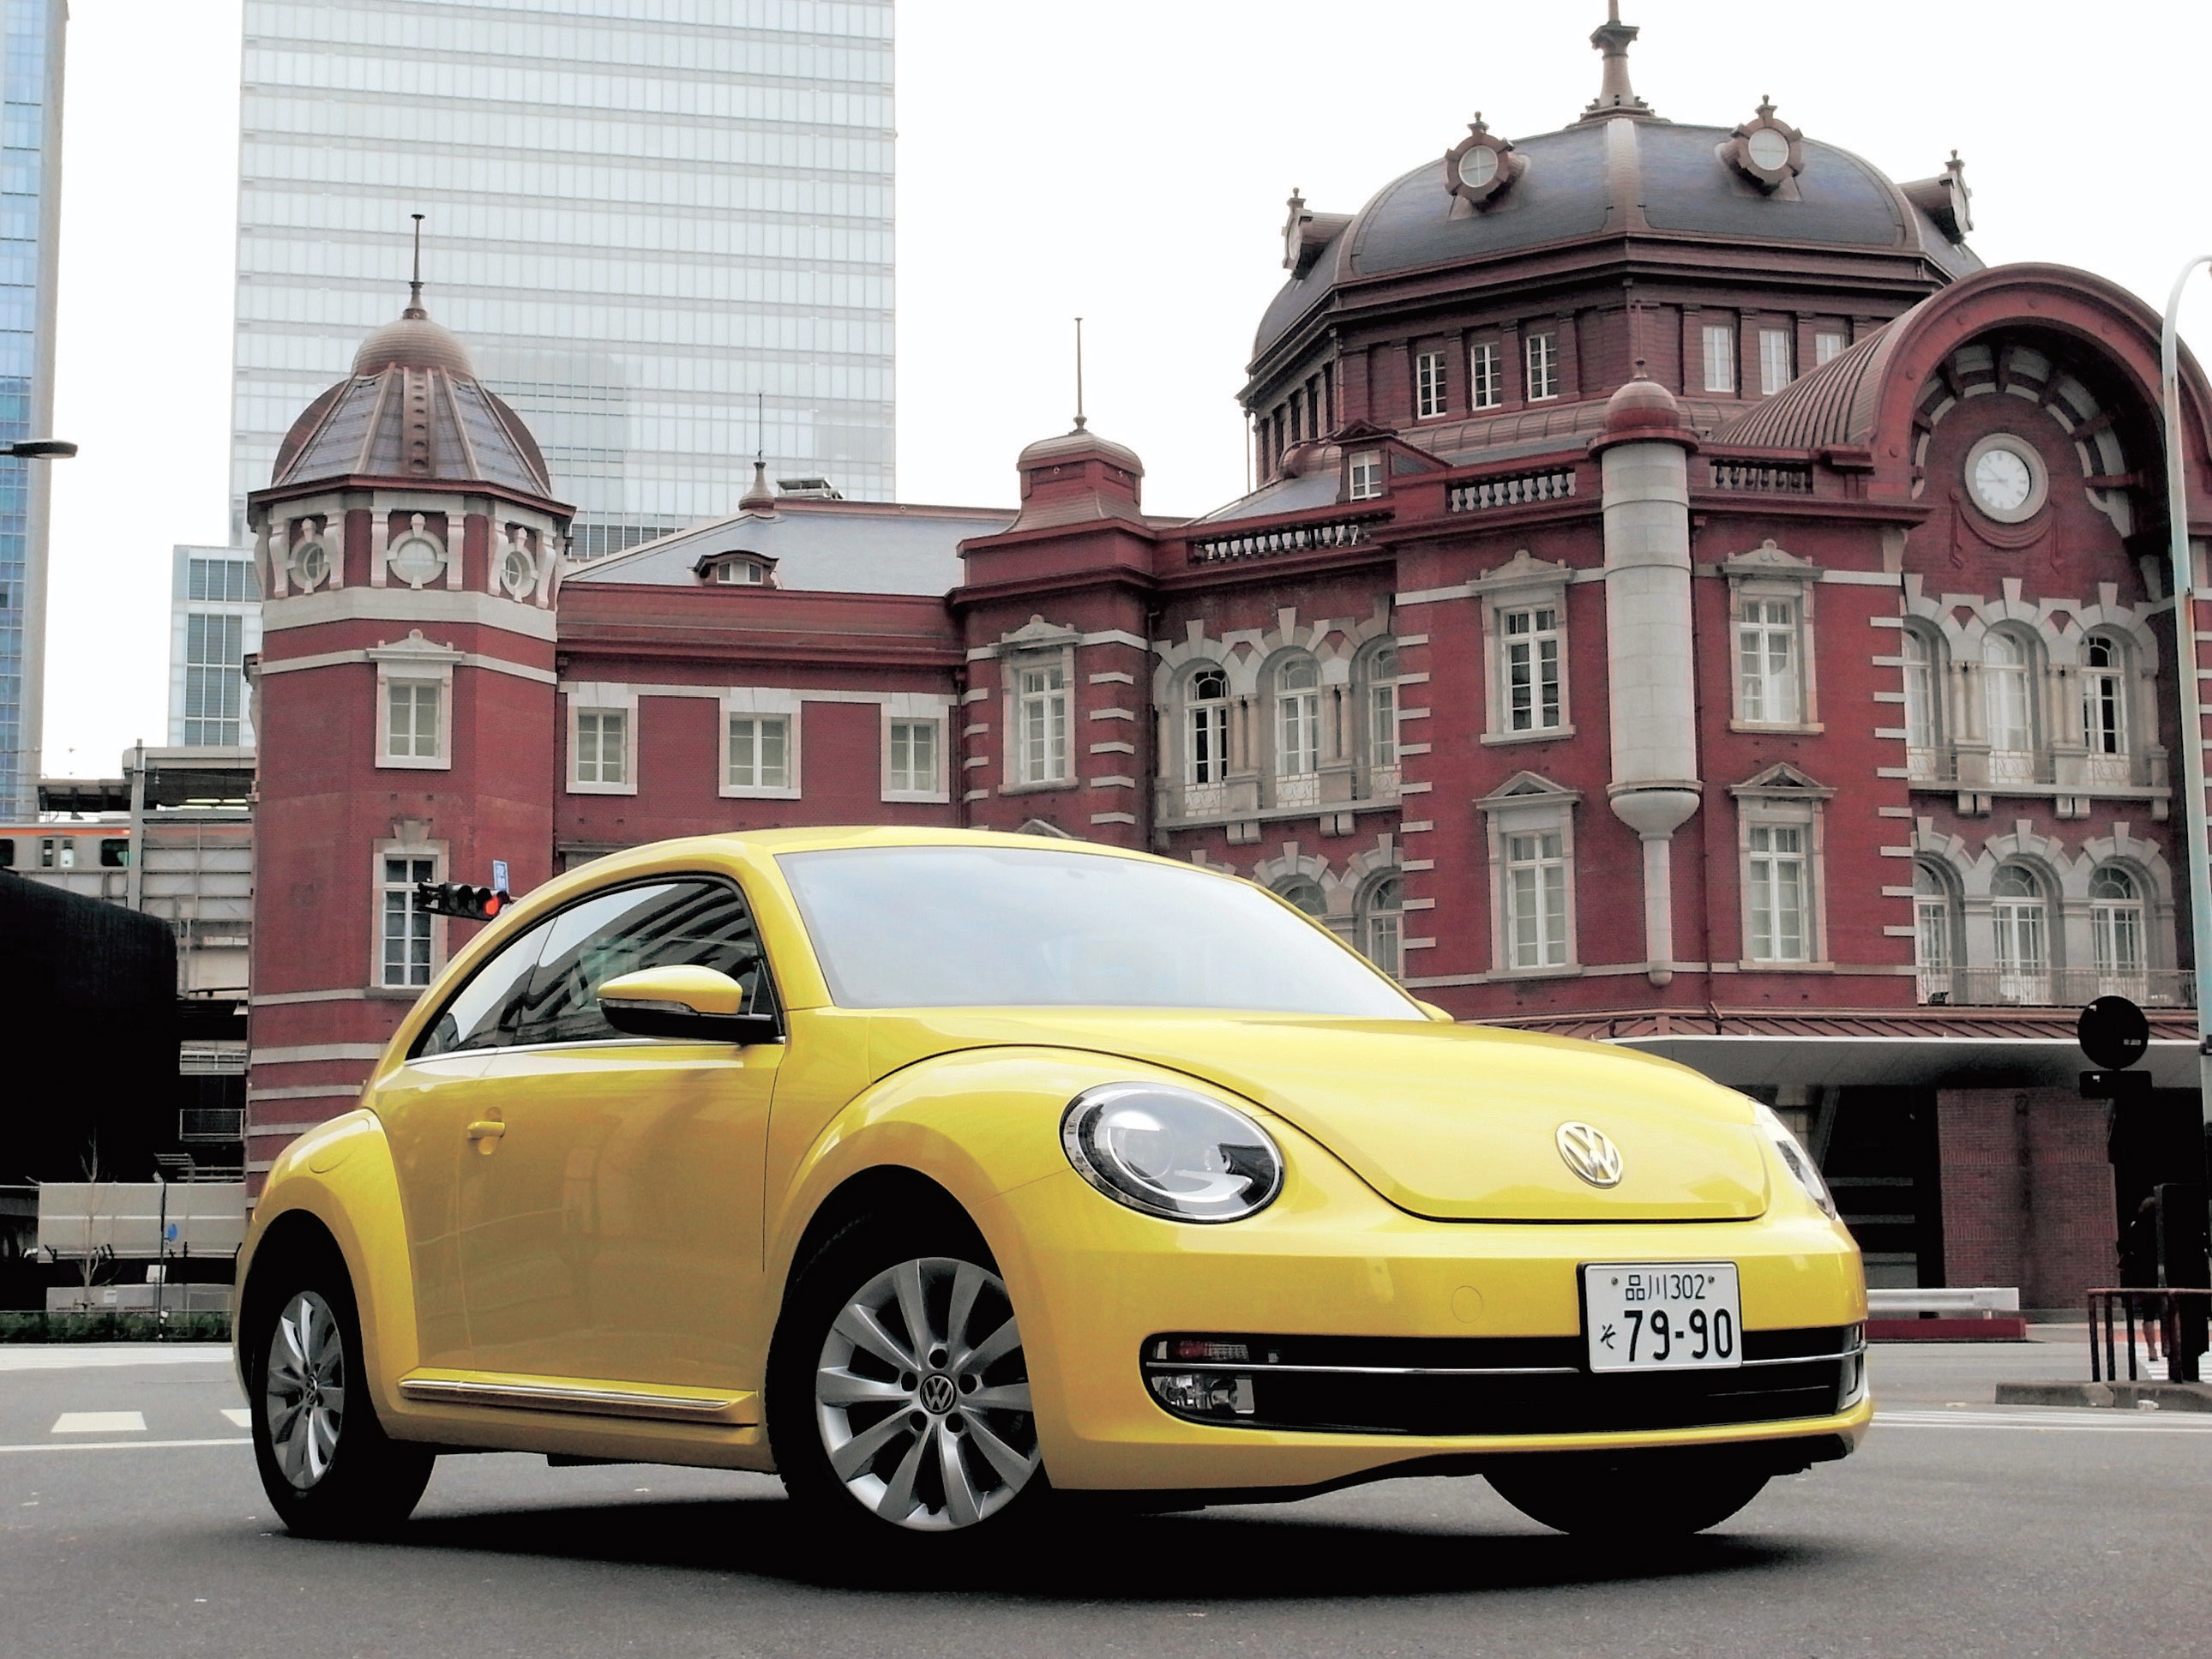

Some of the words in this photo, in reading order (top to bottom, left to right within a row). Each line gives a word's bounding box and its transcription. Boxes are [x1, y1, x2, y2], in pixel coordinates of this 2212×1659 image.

[1557, 1122, 1622, 1188] VW
[1600, 1324, 1616, 1349] そ
[1624, 1308, 1733, 1361] 79-90
[922, 1375, 954, 1413] VW
